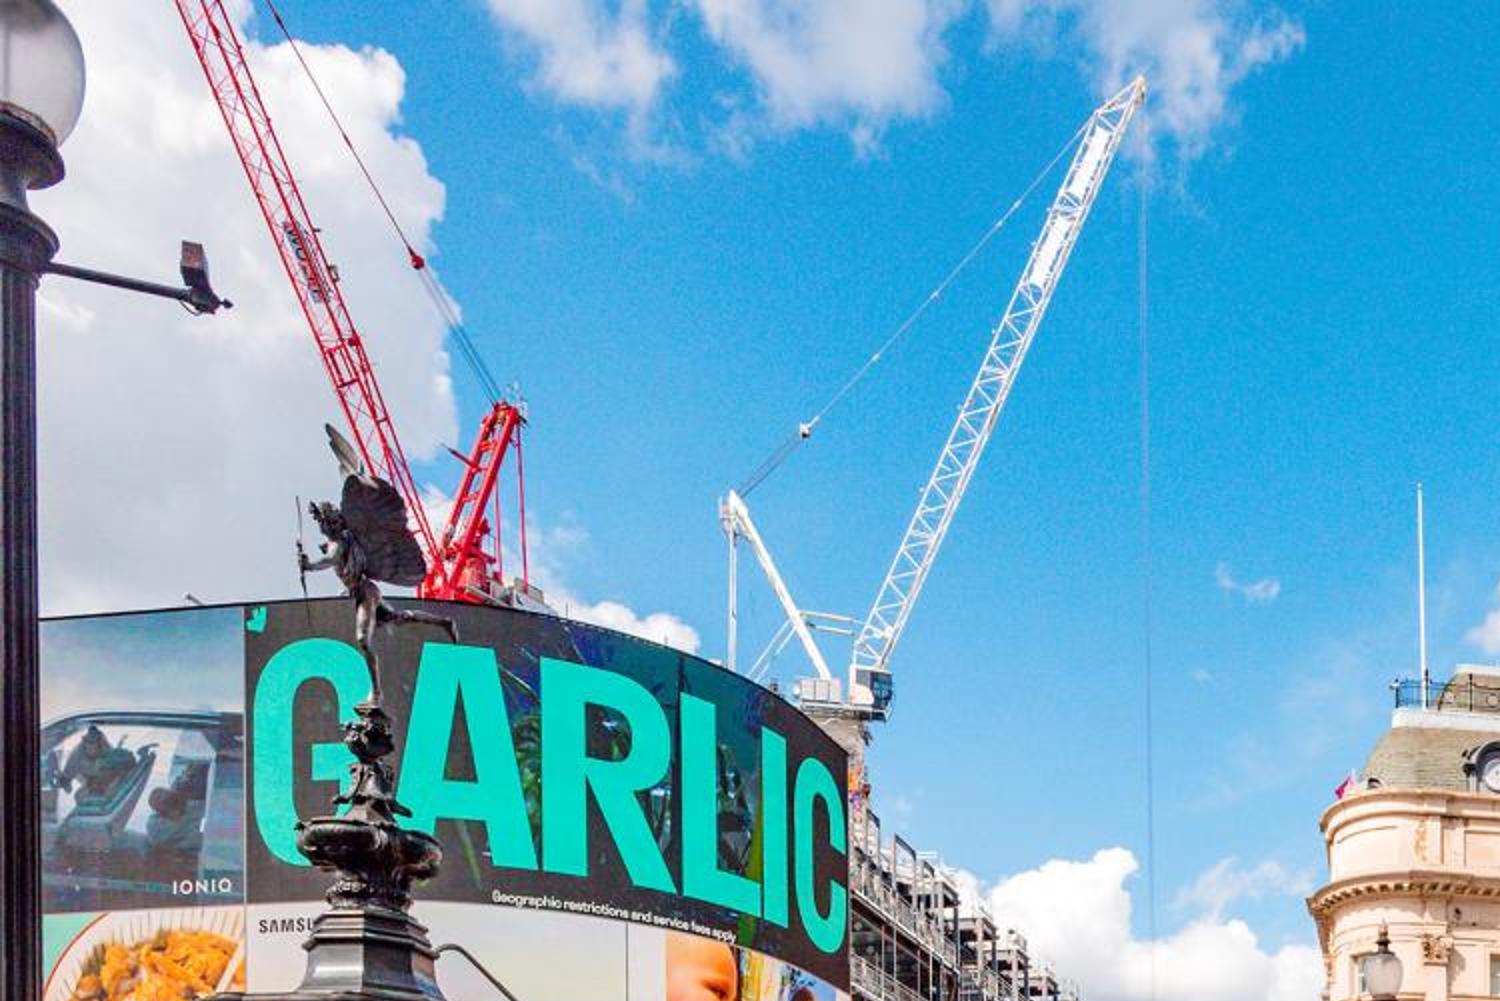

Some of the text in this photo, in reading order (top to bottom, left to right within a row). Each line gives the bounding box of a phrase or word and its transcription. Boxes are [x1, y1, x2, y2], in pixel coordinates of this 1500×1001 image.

[253, 637, 847, 954] GARLIC
[173, 878, 232, 895] IONIQ
[492, 889, 562, 910] Geographic
[564, 900, 628, 920] restrictions
[631, 910, 652, 924] and
[653, 914, 689, 931] service
[713, 925, 737, 944] apply
